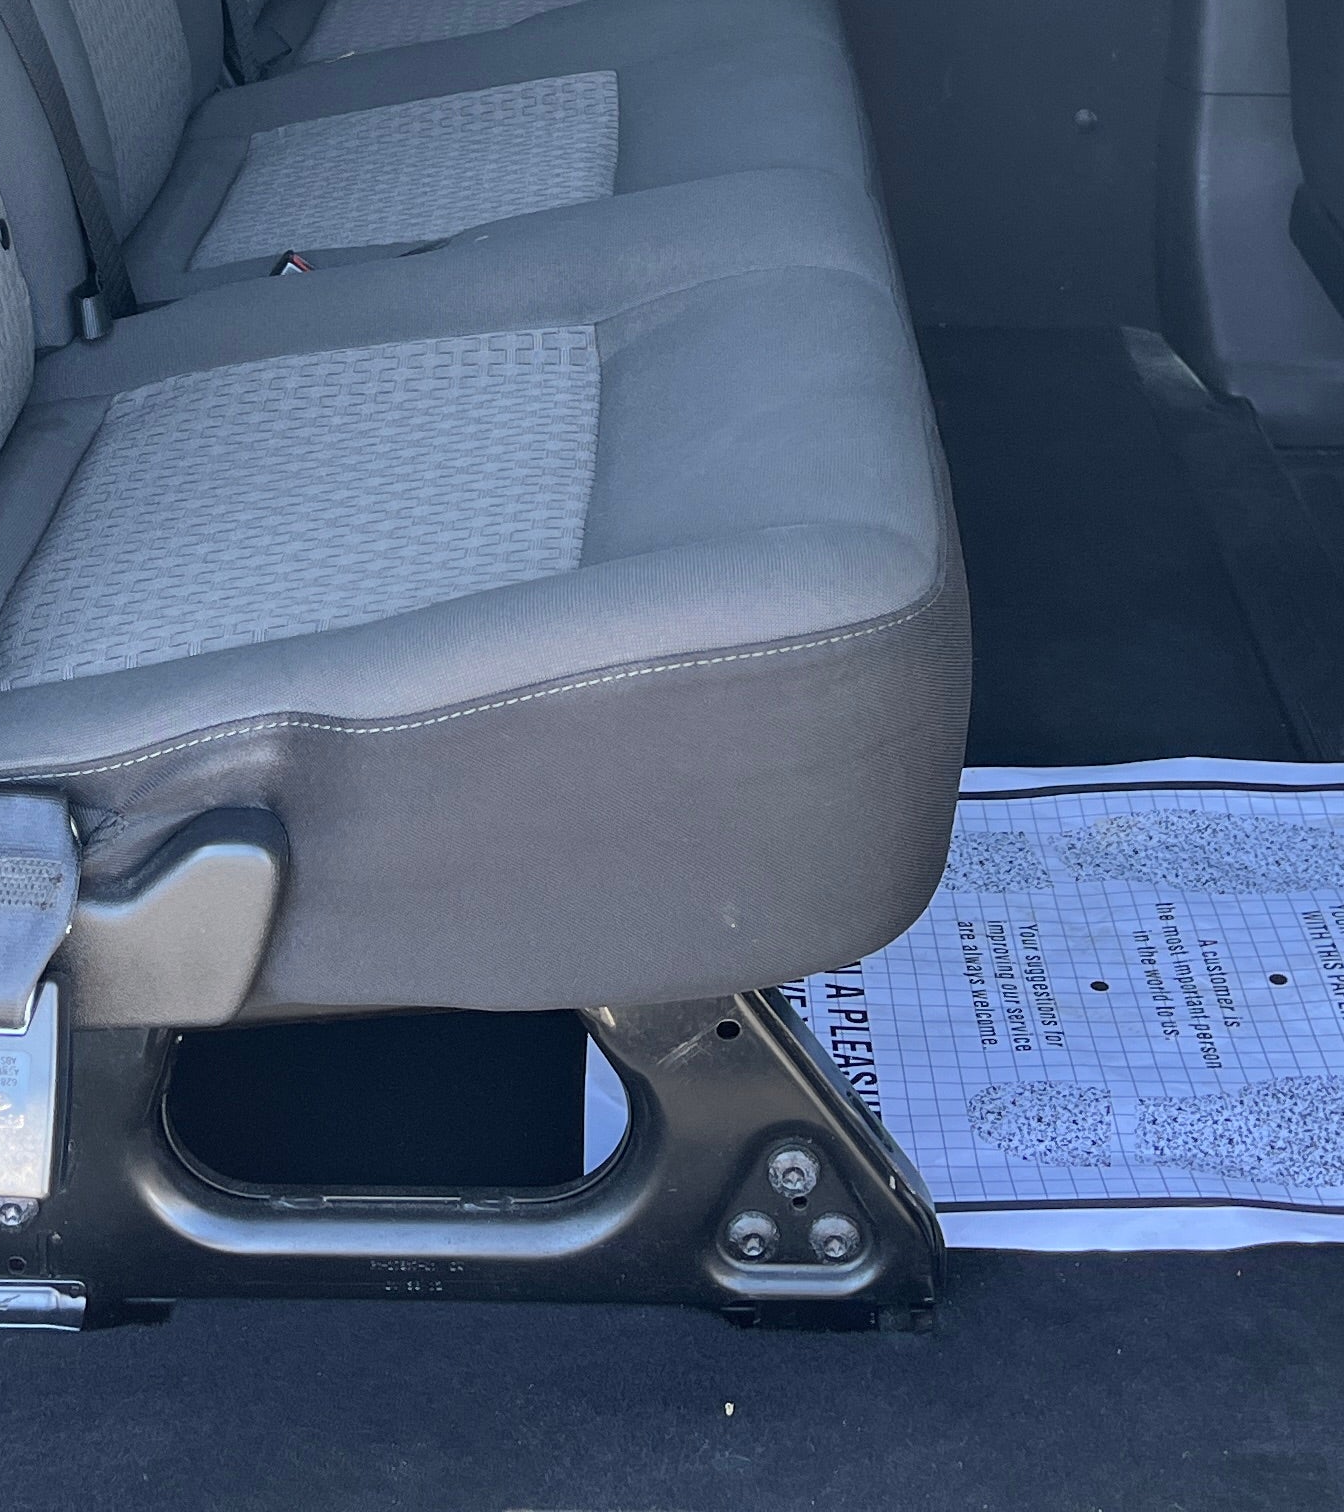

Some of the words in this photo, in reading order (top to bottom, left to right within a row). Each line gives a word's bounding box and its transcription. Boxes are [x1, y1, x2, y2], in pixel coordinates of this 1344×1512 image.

[1156, 902, 1175, 921] the
[1302, 910, 1332, 940] WITH
[957, 921, 976, 941] are
[1019, 923, 1039, 951] Your
[1132, 930, 1150, 945] in
[1163, 925, 1189, 957] most
[1198, 939, 1218, 950] A
[962, 944, 985, 985] always
[987, 920, 1015, 980] improving
[1137, 946, 1158, 967] the
[1315, 943, 1344, 970] THIS
[825, 983, 865, 999] A
[1001, 983, 1021, 1006] our
[1023, 955, 1058, 1027] suggestions
[1144, 969, 1169, 1003] world
[1173, 959, 1210, 1019] important
[1201, 951, 1236, 1011] customer
[973, 988, 998, 1050] welcome.
[1155, 1006, 1175, 1018] to
[1223, 1016, 1243, 1028] is
[1007, 1008, 1032, 1052] service
[1045, 1029, 1065, 1048] for
[1189, 1023, 1222, 1069] person
[828, 1008, 883, 1123] PLEAS
